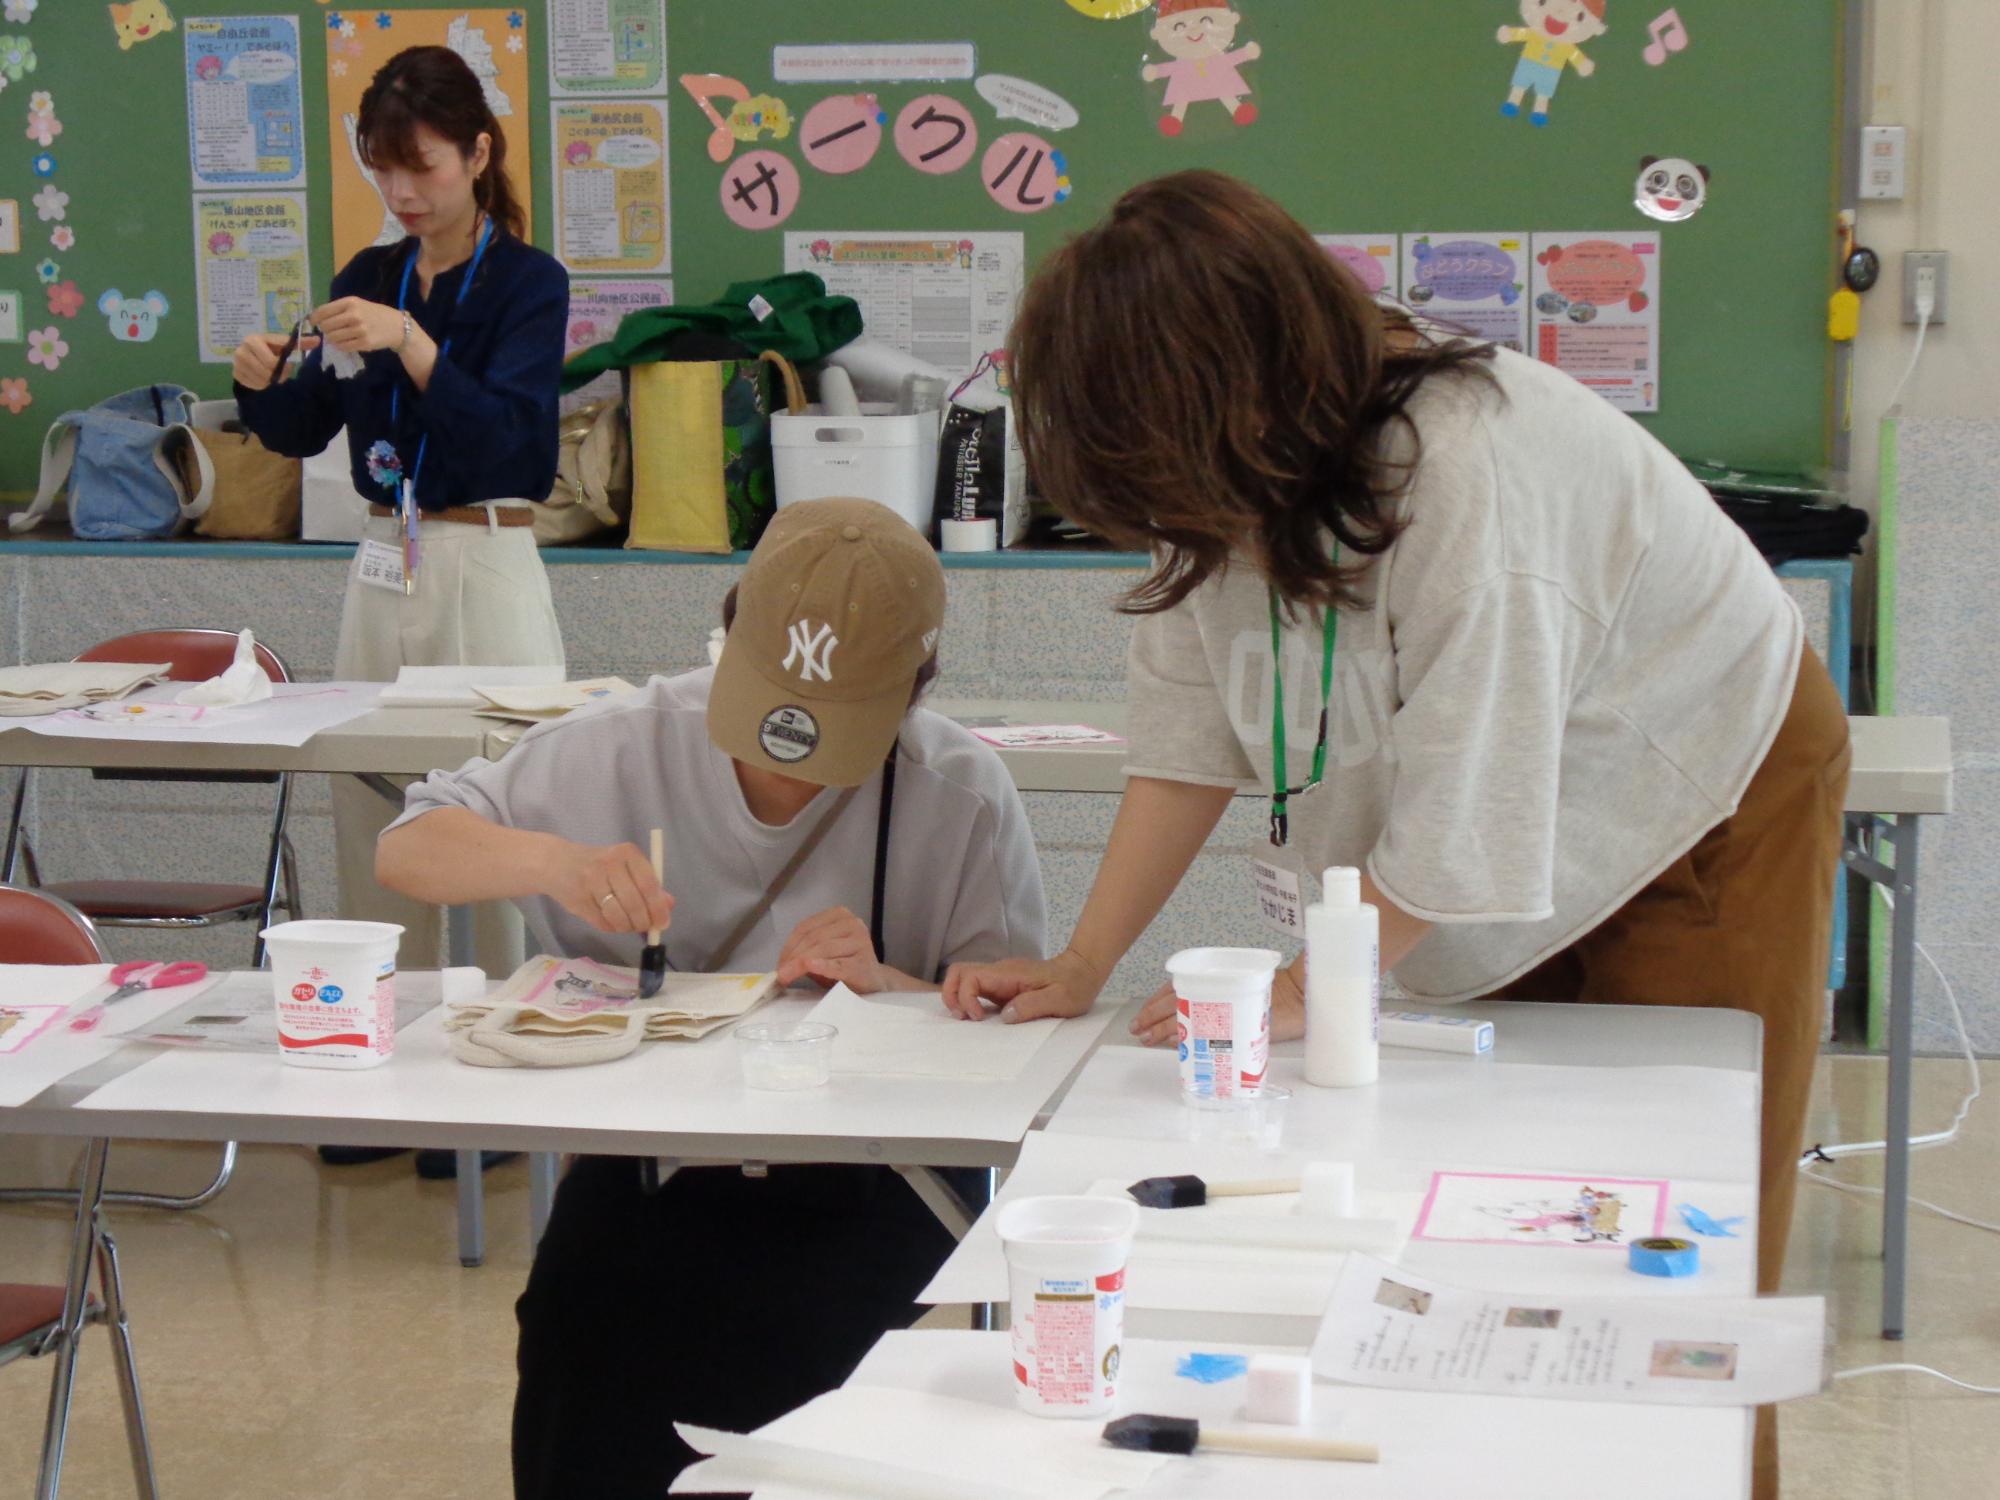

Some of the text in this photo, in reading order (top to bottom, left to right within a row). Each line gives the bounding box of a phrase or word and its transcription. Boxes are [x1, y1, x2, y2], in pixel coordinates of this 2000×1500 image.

[733, 105, 1045, 215] サークル
[782, 619, 839, 682] NY
